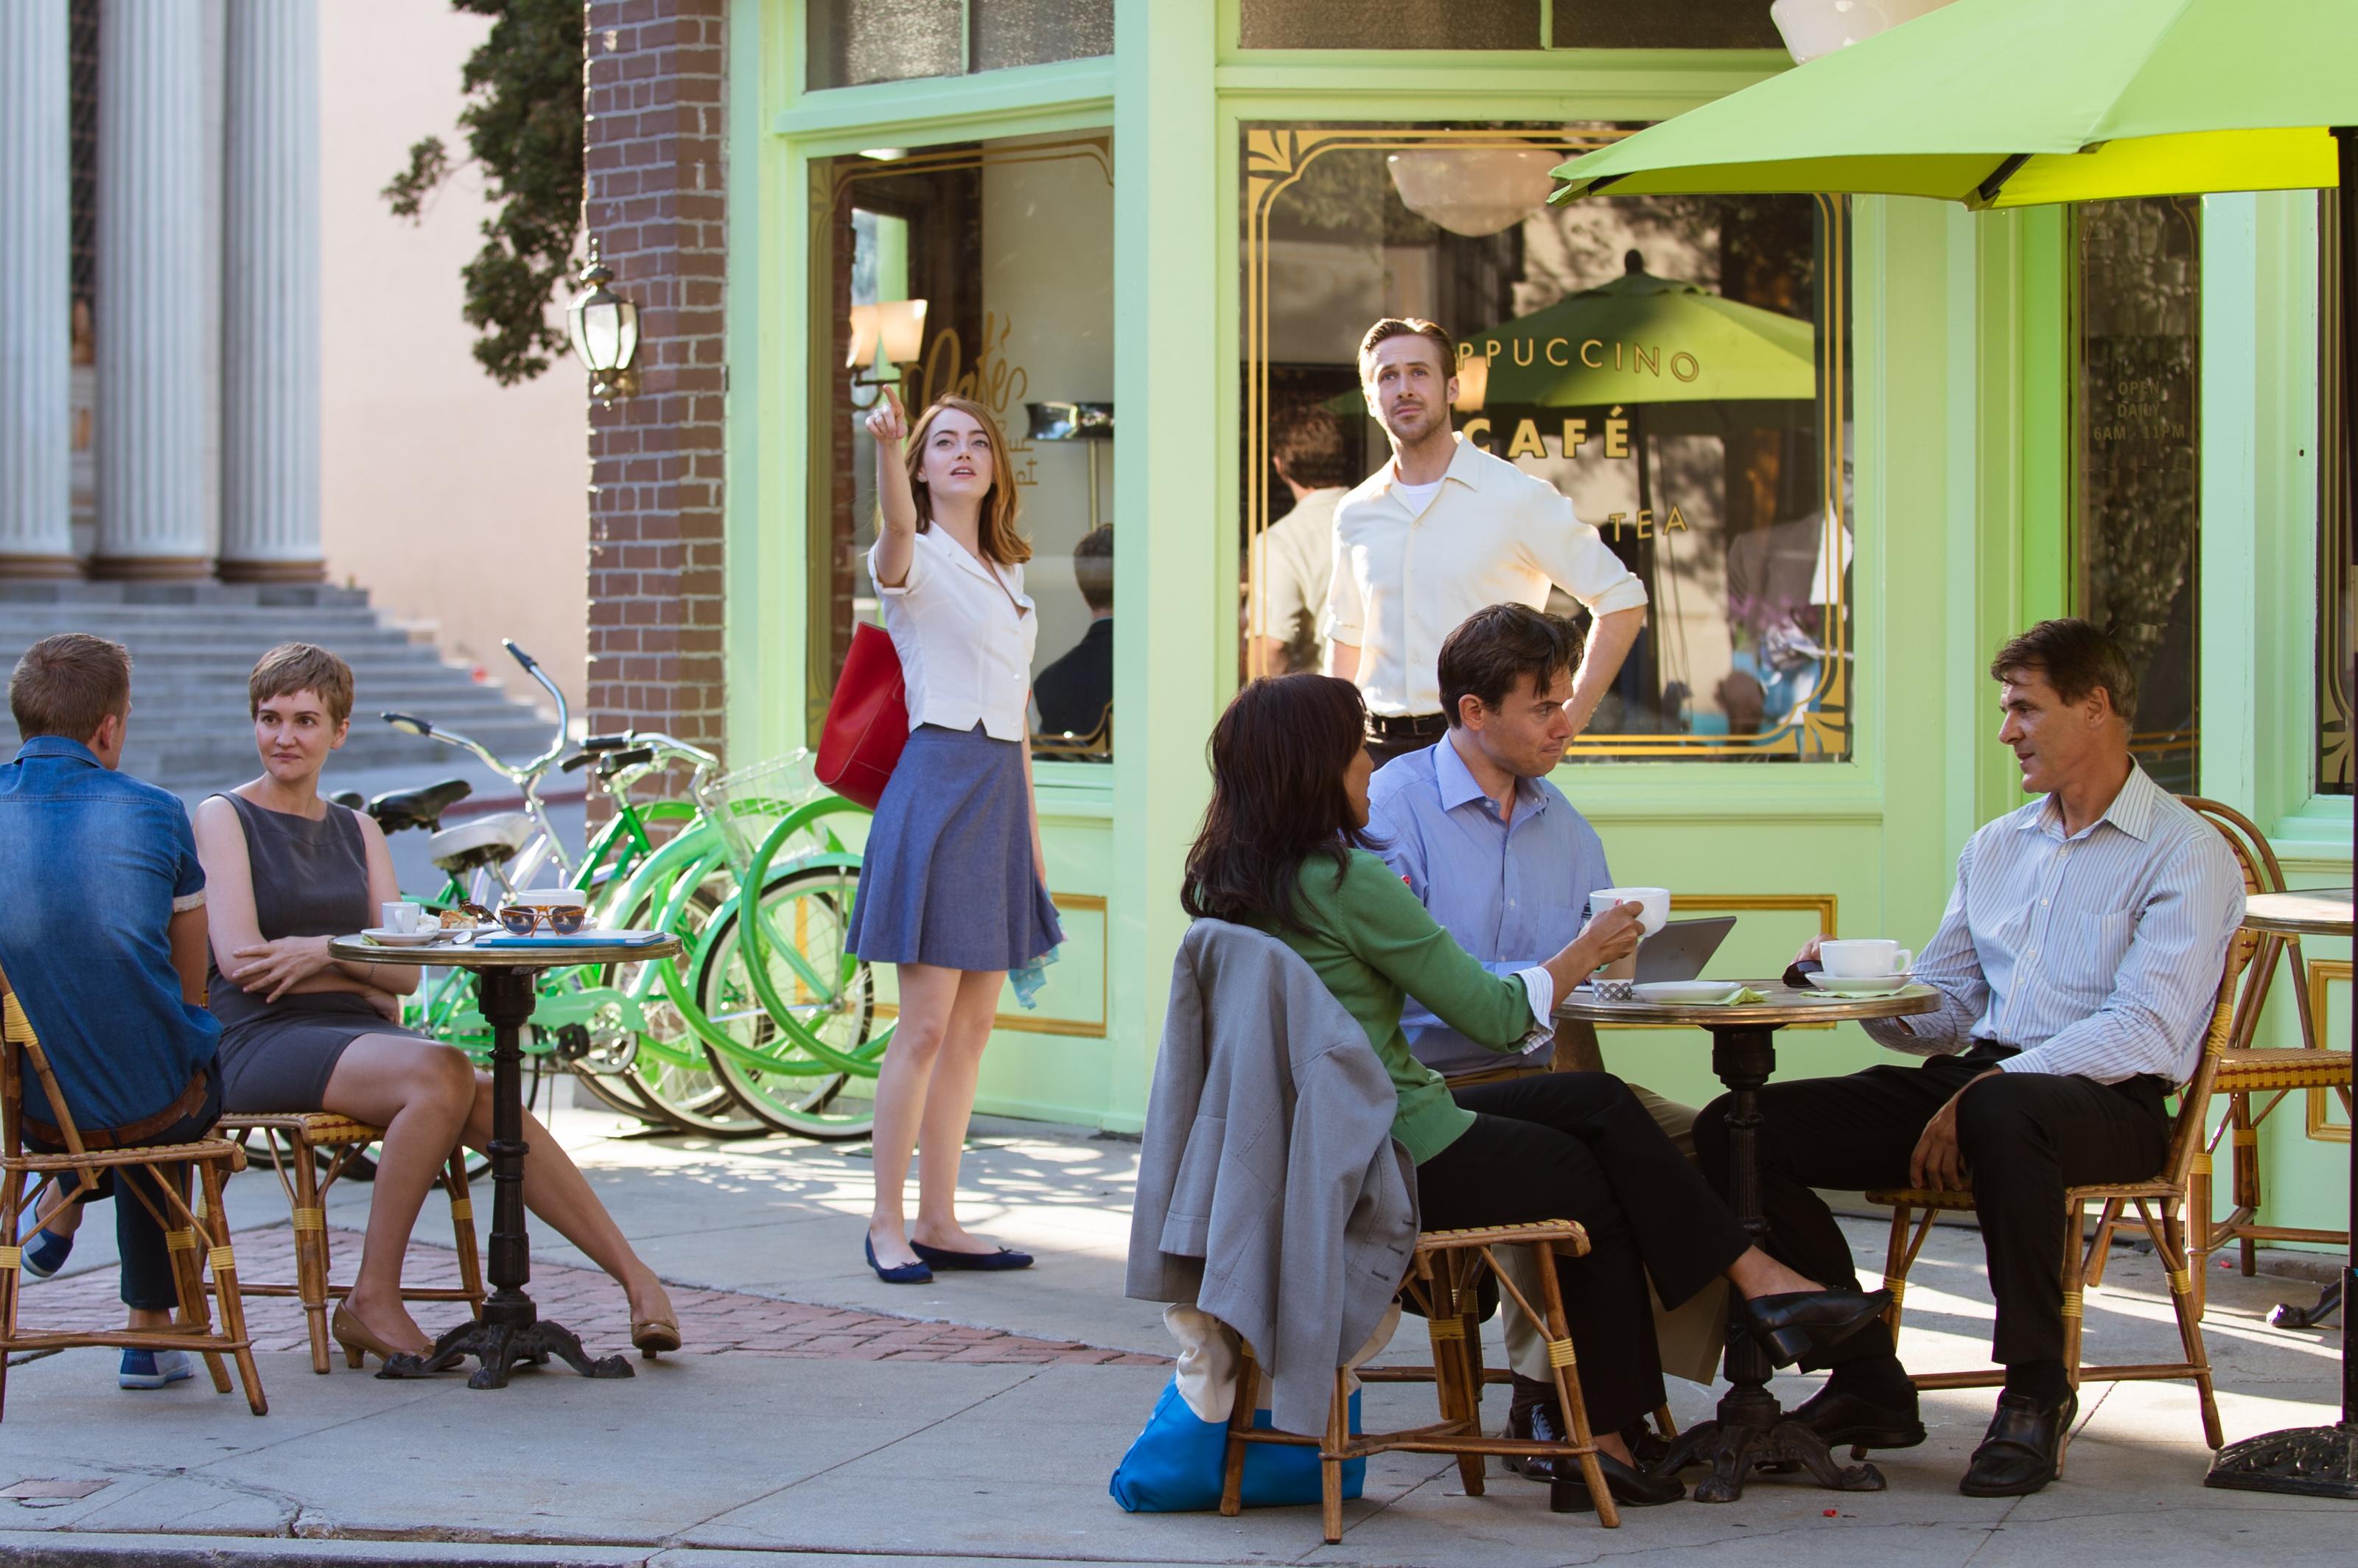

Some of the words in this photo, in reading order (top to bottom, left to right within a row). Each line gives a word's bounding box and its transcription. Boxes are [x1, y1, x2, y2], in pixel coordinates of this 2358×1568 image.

[1458, 338, 1699, 382] PPUCCINO
[2118, 380, 2160, 396] OPEN
[2117, 402, 2161, 418] DAILY
[1462, 405, 1630, 458] CAFÉ
[2093, 425, 2127, 441] 6AM
[2143, 424, 2186, 439] 11PM
[1609, 504, 1688, 543] TEA
